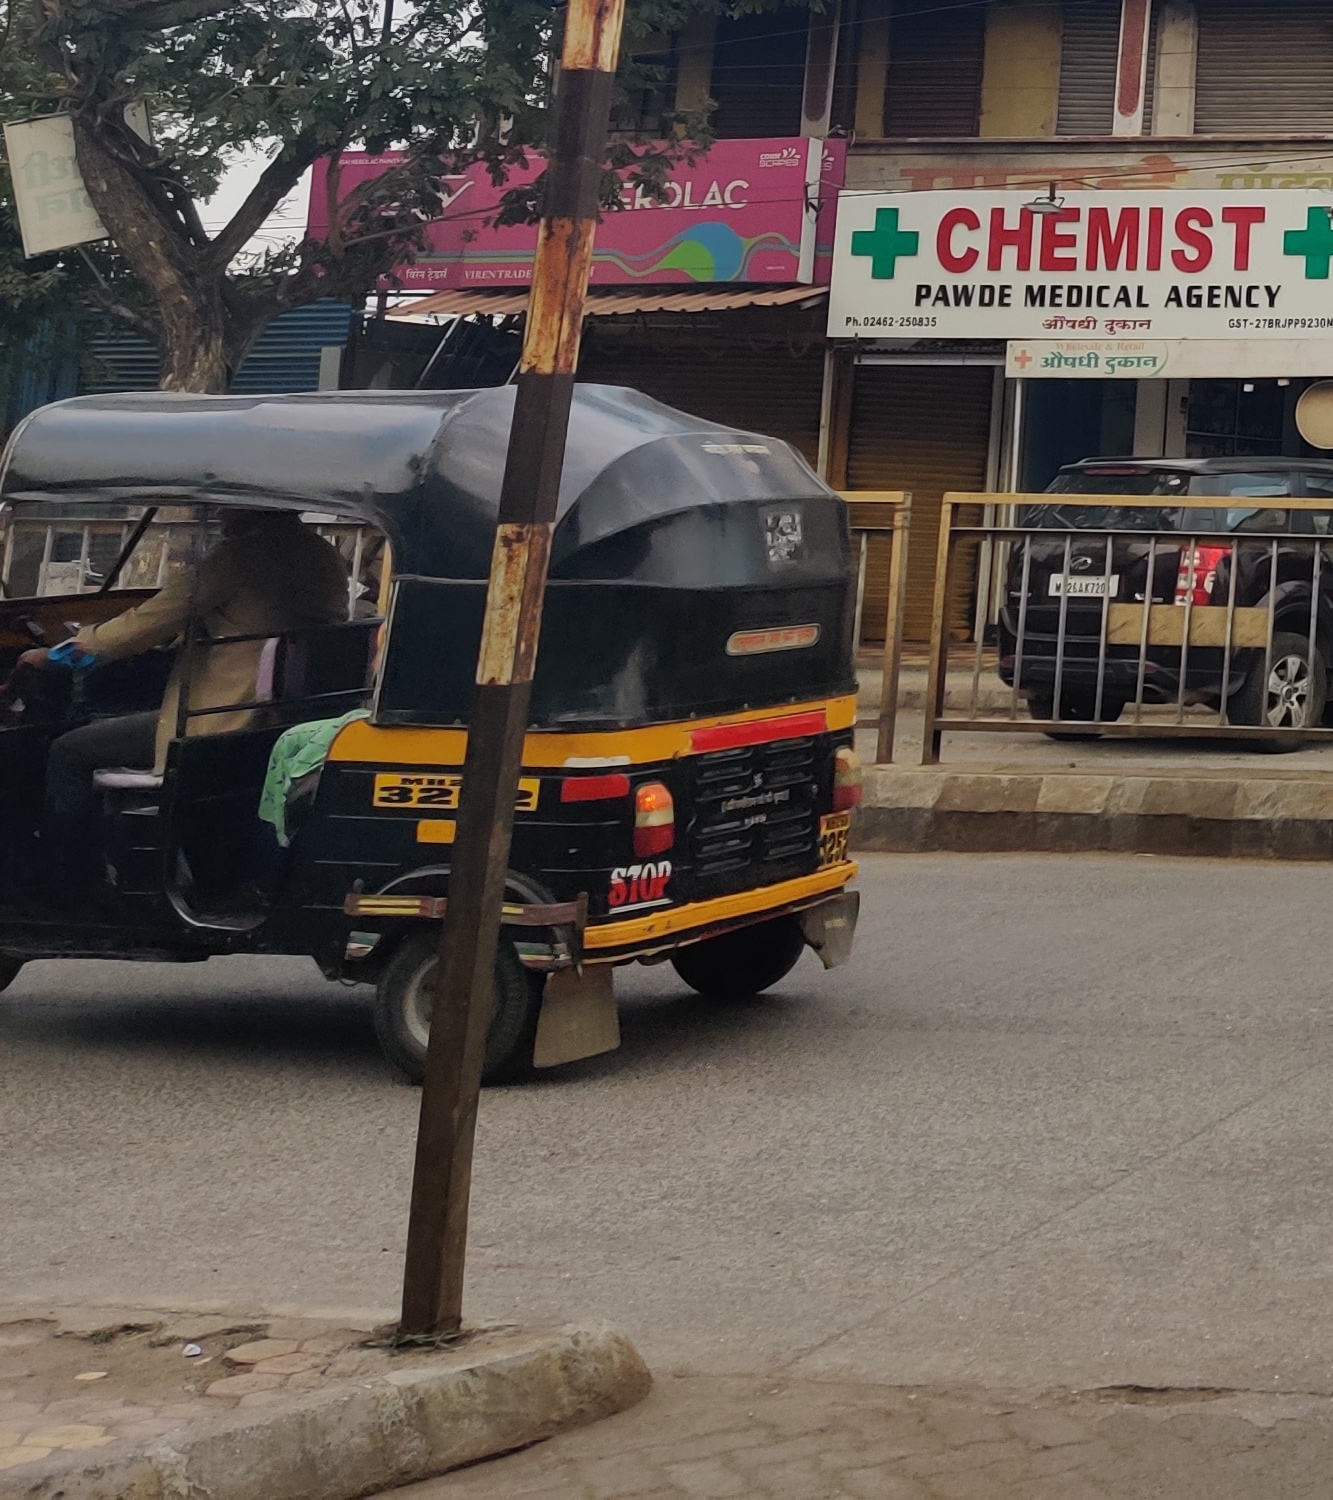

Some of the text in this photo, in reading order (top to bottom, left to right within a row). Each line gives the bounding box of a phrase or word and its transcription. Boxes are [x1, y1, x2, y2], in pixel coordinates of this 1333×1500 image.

[619, 180, 750, 211] EROLAC
[936, 206, 1266, 274] CHEMIST
[465, 269, 532, 279] VIREN TRADE
[914, 284, 1282, 309] PAWDE MEDICAL AGENCY
[1104, 318, 1152, 335] दुकान
[1040, 351, 1158, 375] औषधी दुकान
[608, 861, 672, 907] STOP
